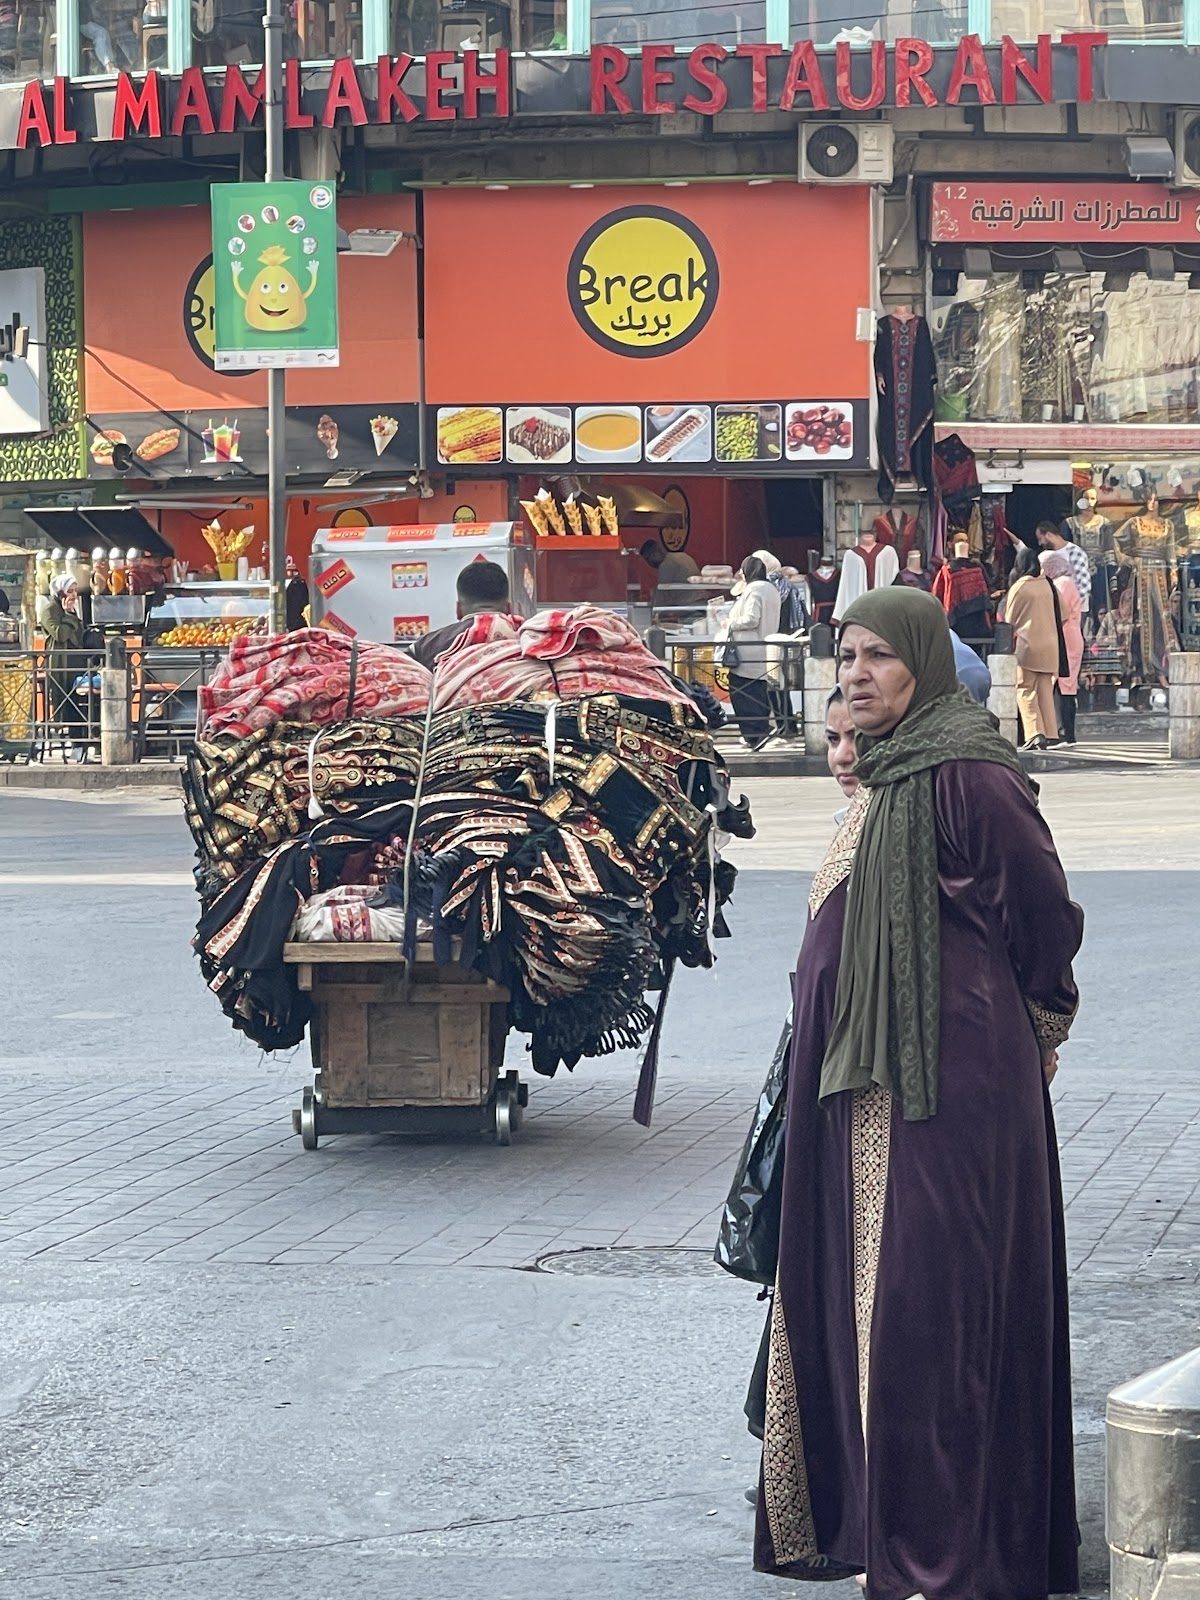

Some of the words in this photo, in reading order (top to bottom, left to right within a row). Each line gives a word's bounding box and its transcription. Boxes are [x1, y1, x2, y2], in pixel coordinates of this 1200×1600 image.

[16, 76, 77, 149] AL
[112, 48, 510, 141] MAMLAKEH
[590, 32, 1109, 115] RESTAURANT
[944, 186, 968, 200] 1.2
[970, 196, 1064, 229] الشرقية
[1073, 199, 1181, 230] للمطرزات
[577, 257, 708, 306] Break
[611, 305, 672, 337] بريك
